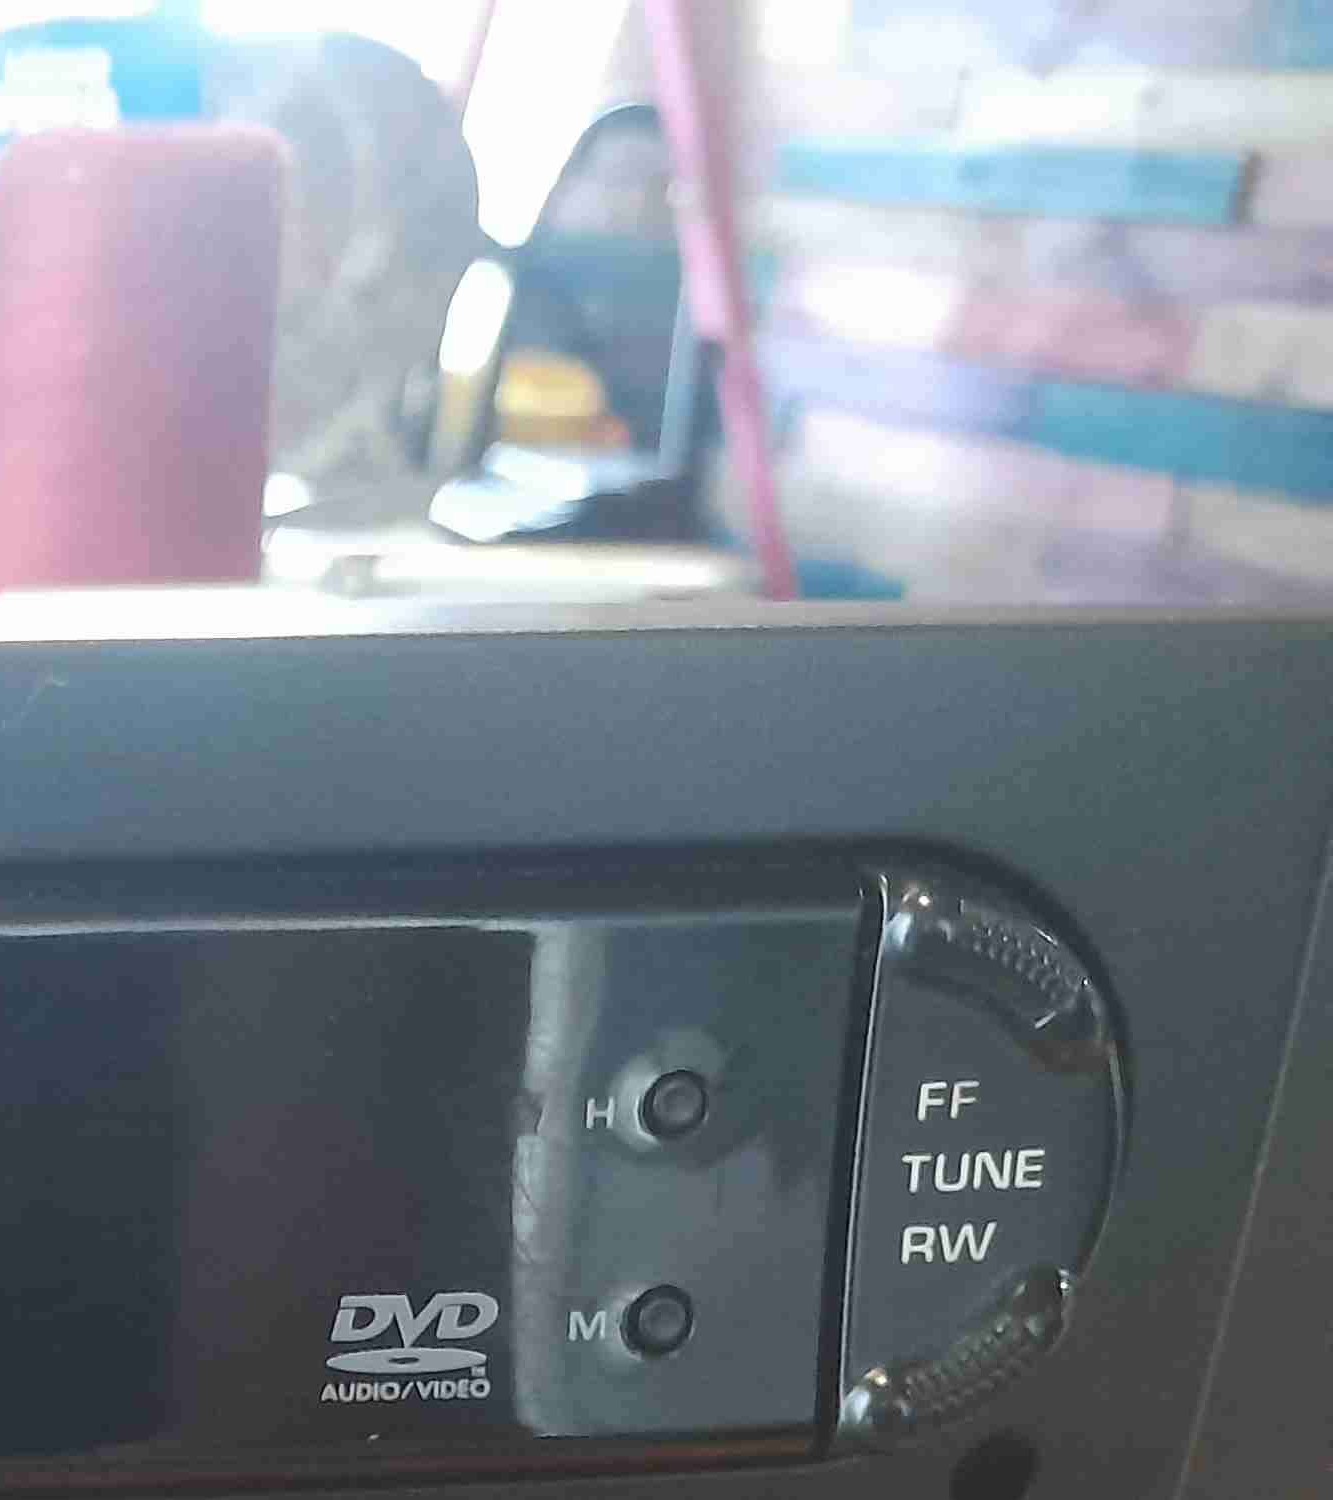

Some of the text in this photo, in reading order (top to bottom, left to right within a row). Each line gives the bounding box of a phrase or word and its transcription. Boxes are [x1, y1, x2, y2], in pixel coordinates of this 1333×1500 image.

[585, 1098, 616, 1130] H
[916, 1080, 981, 1121] FF
[901, 1149, 1046, 1193] TUNE
[900, 1222, 997, 1265] RW
[331, 1291, 499, 1349] DVD
[567, 1311, 607, 1343] M
[320, 1377, 492, 1402] AUDIO/VIDEO
